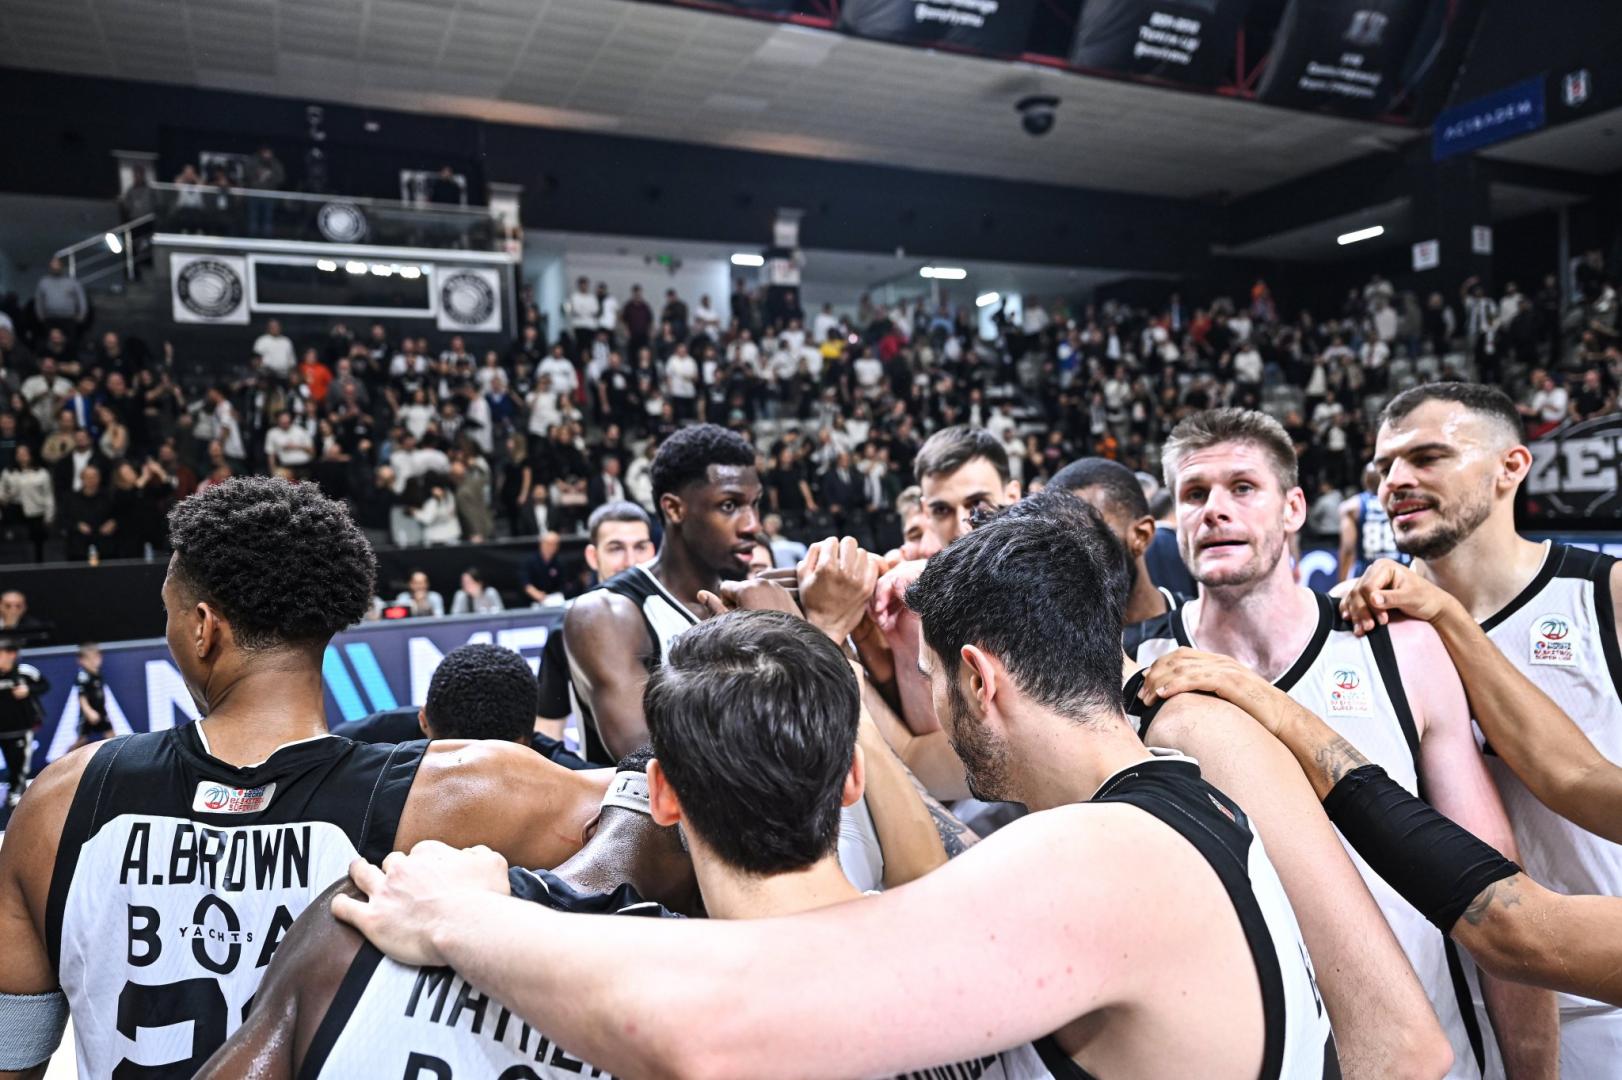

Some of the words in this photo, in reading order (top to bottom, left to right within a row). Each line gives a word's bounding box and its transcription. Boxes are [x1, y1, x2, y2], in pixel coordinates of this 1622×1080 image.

[1527, 437, 1622, 493] ZE
[119, 822, 311, 892] A.BROWN
[179, 926, 253, 942] YACHTS
